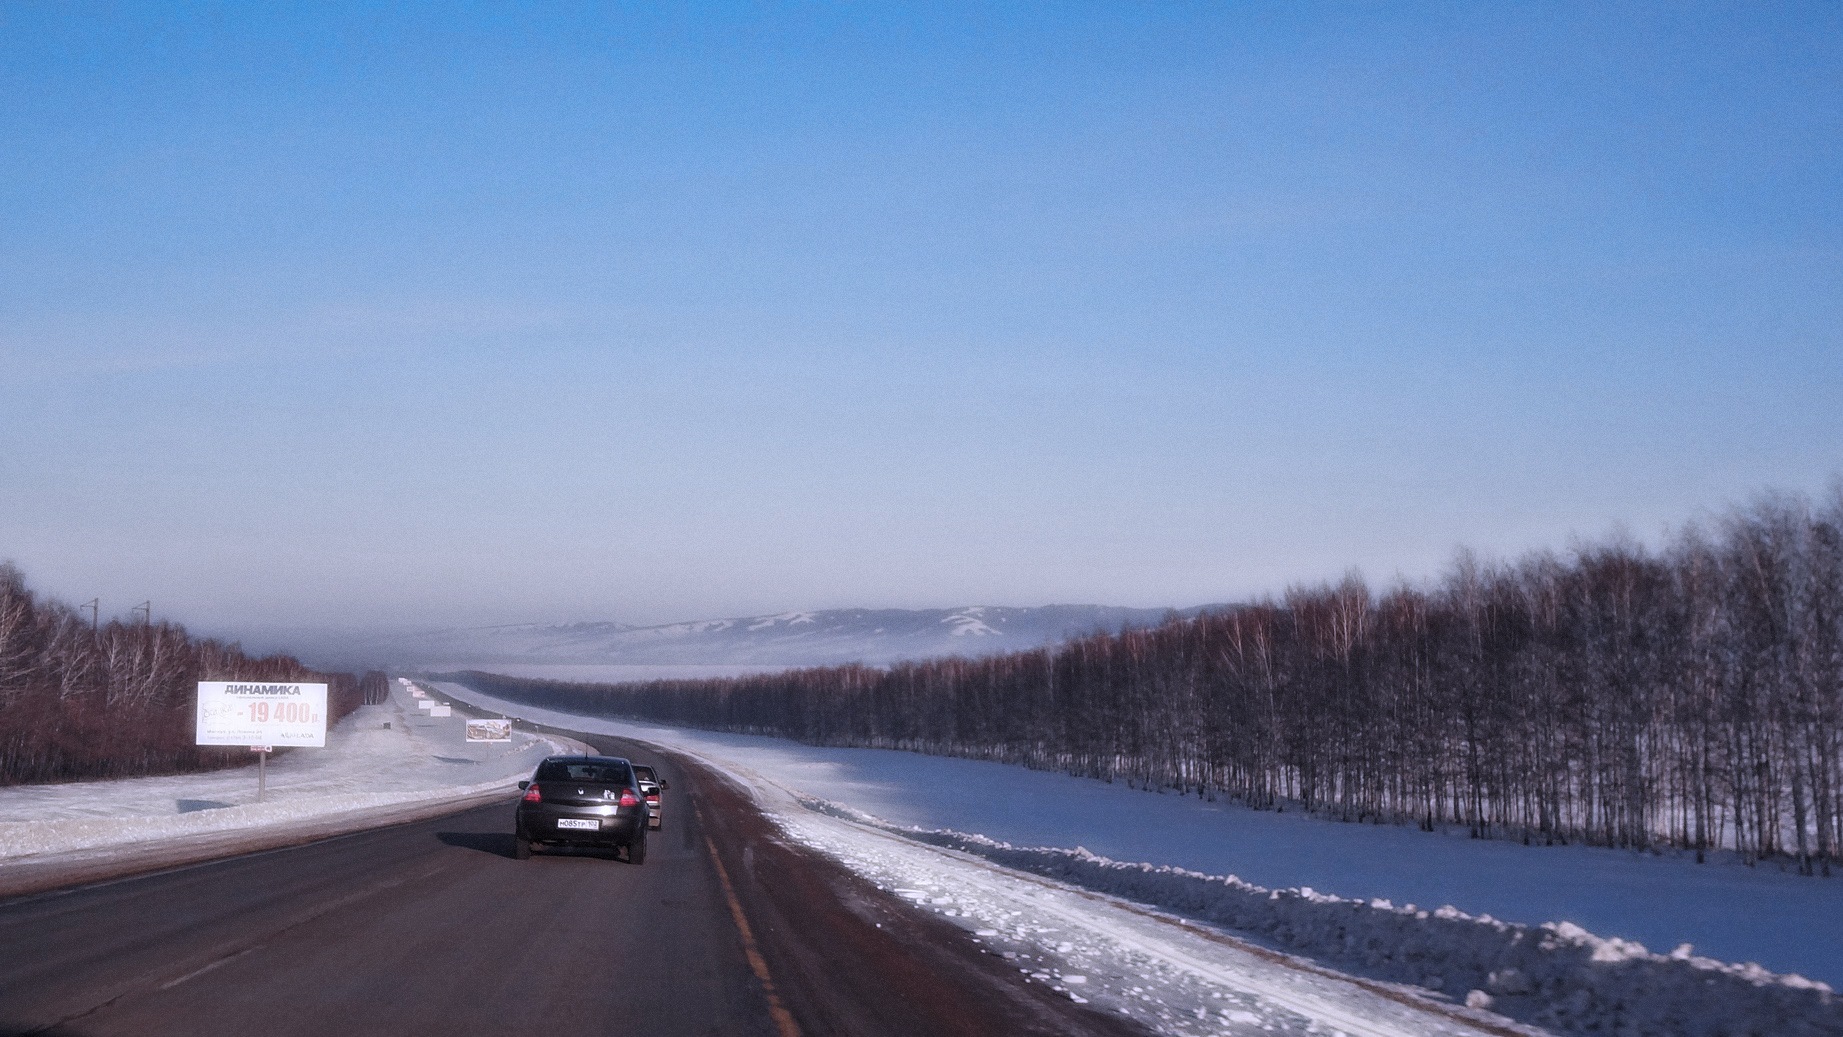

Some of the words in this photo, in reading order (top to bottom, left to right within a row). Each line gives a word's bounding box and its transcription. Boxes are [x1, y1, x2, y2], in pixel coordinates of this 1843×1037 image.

[225, 684, 301, 695] ДИНАМИКА
[248, 701, 269, 722] 19
[273, 701, 310, 723] 400
